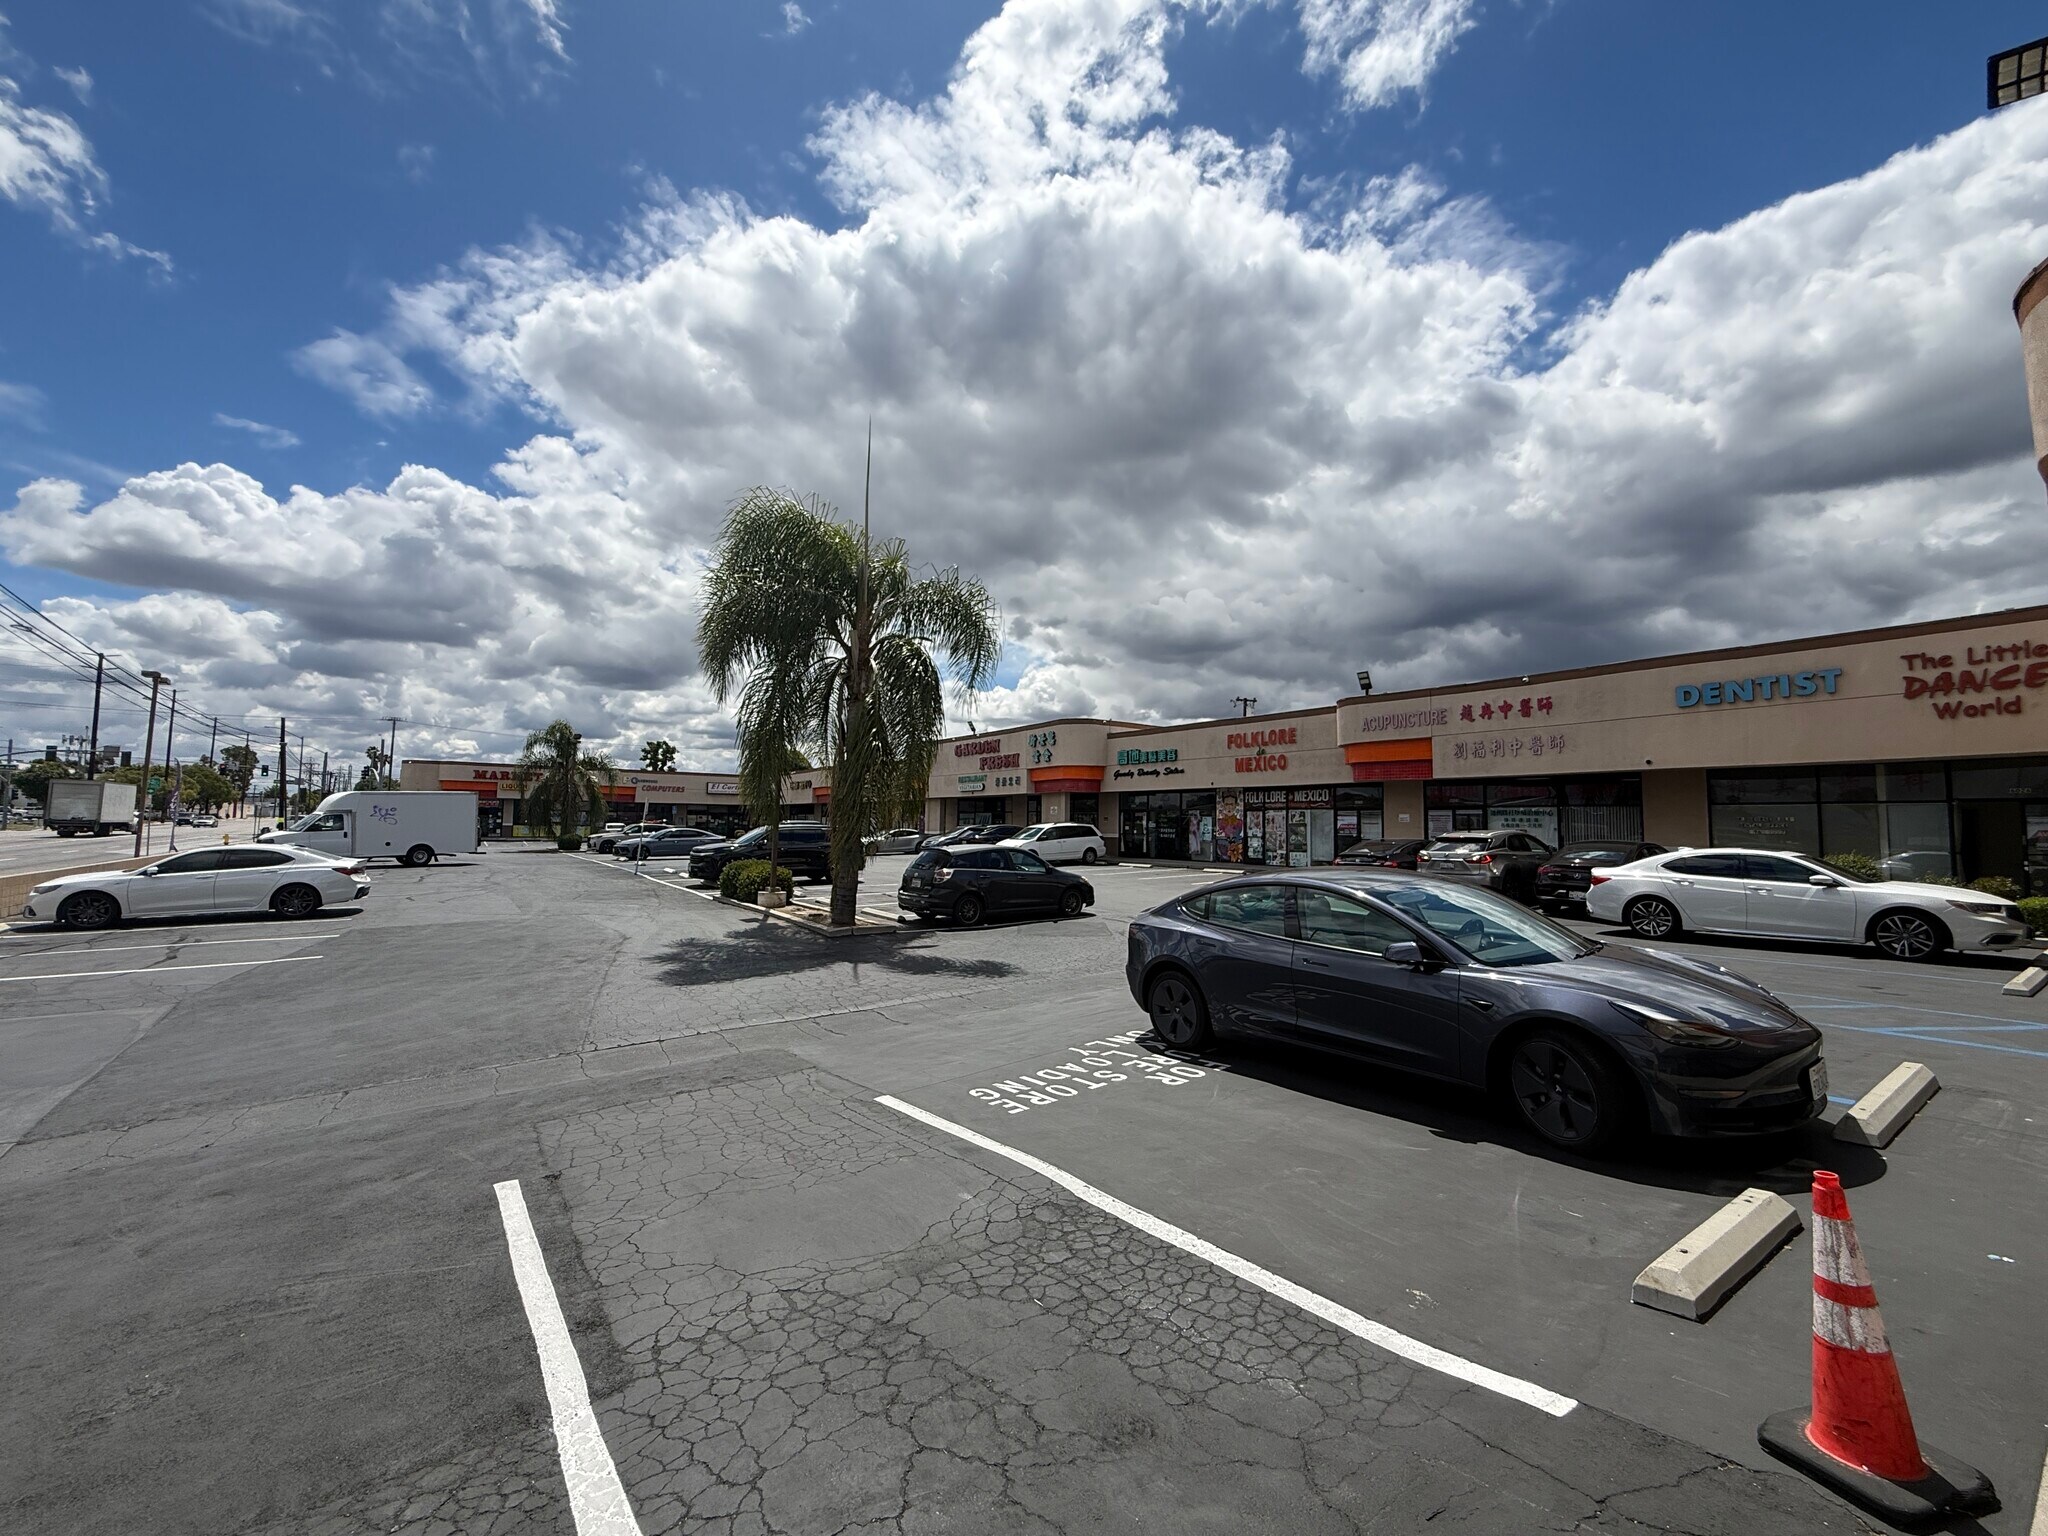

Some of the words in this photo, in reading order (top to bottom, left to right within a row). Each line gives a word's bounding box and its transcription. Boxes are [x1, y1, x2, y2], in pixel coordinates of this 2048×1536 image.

[1900, 652, 1953, 671] The
[1967, 640, 2048, 666] Little
[1674, 668, 1843, 709] DENTIST
[1902, 661, 2048, 700] DANCE
[1360, 707, 1448, 733] ACUPUNCTURE
[1932, 695, 2022, 720] World
[954, 738, 1001, 758] GARDEN
[1227, 727, 1297, 750] FOLKLORE
[1256, 745, 1266, 756] de
[1453, 734, 1566, 761] 劉福利中醫師
[979, 753, 1021, 771] FRESH
[1235, 754, 1289, 773] MEXICO
[641, 784, 686, 793] COMPUTERS
[711, 782, 720, 790] El
[958, 774, 988, 784] RESTAURANT
[1294, 789, 1329, 802] MEXICO
[1069, 1030, 1155, 1057] ONLY
[968, 1050, 1138, 1102] LOADING
[1145, 1060, 1231, 1086] FOR
[988, 1070, 1128, 1114] STORE
